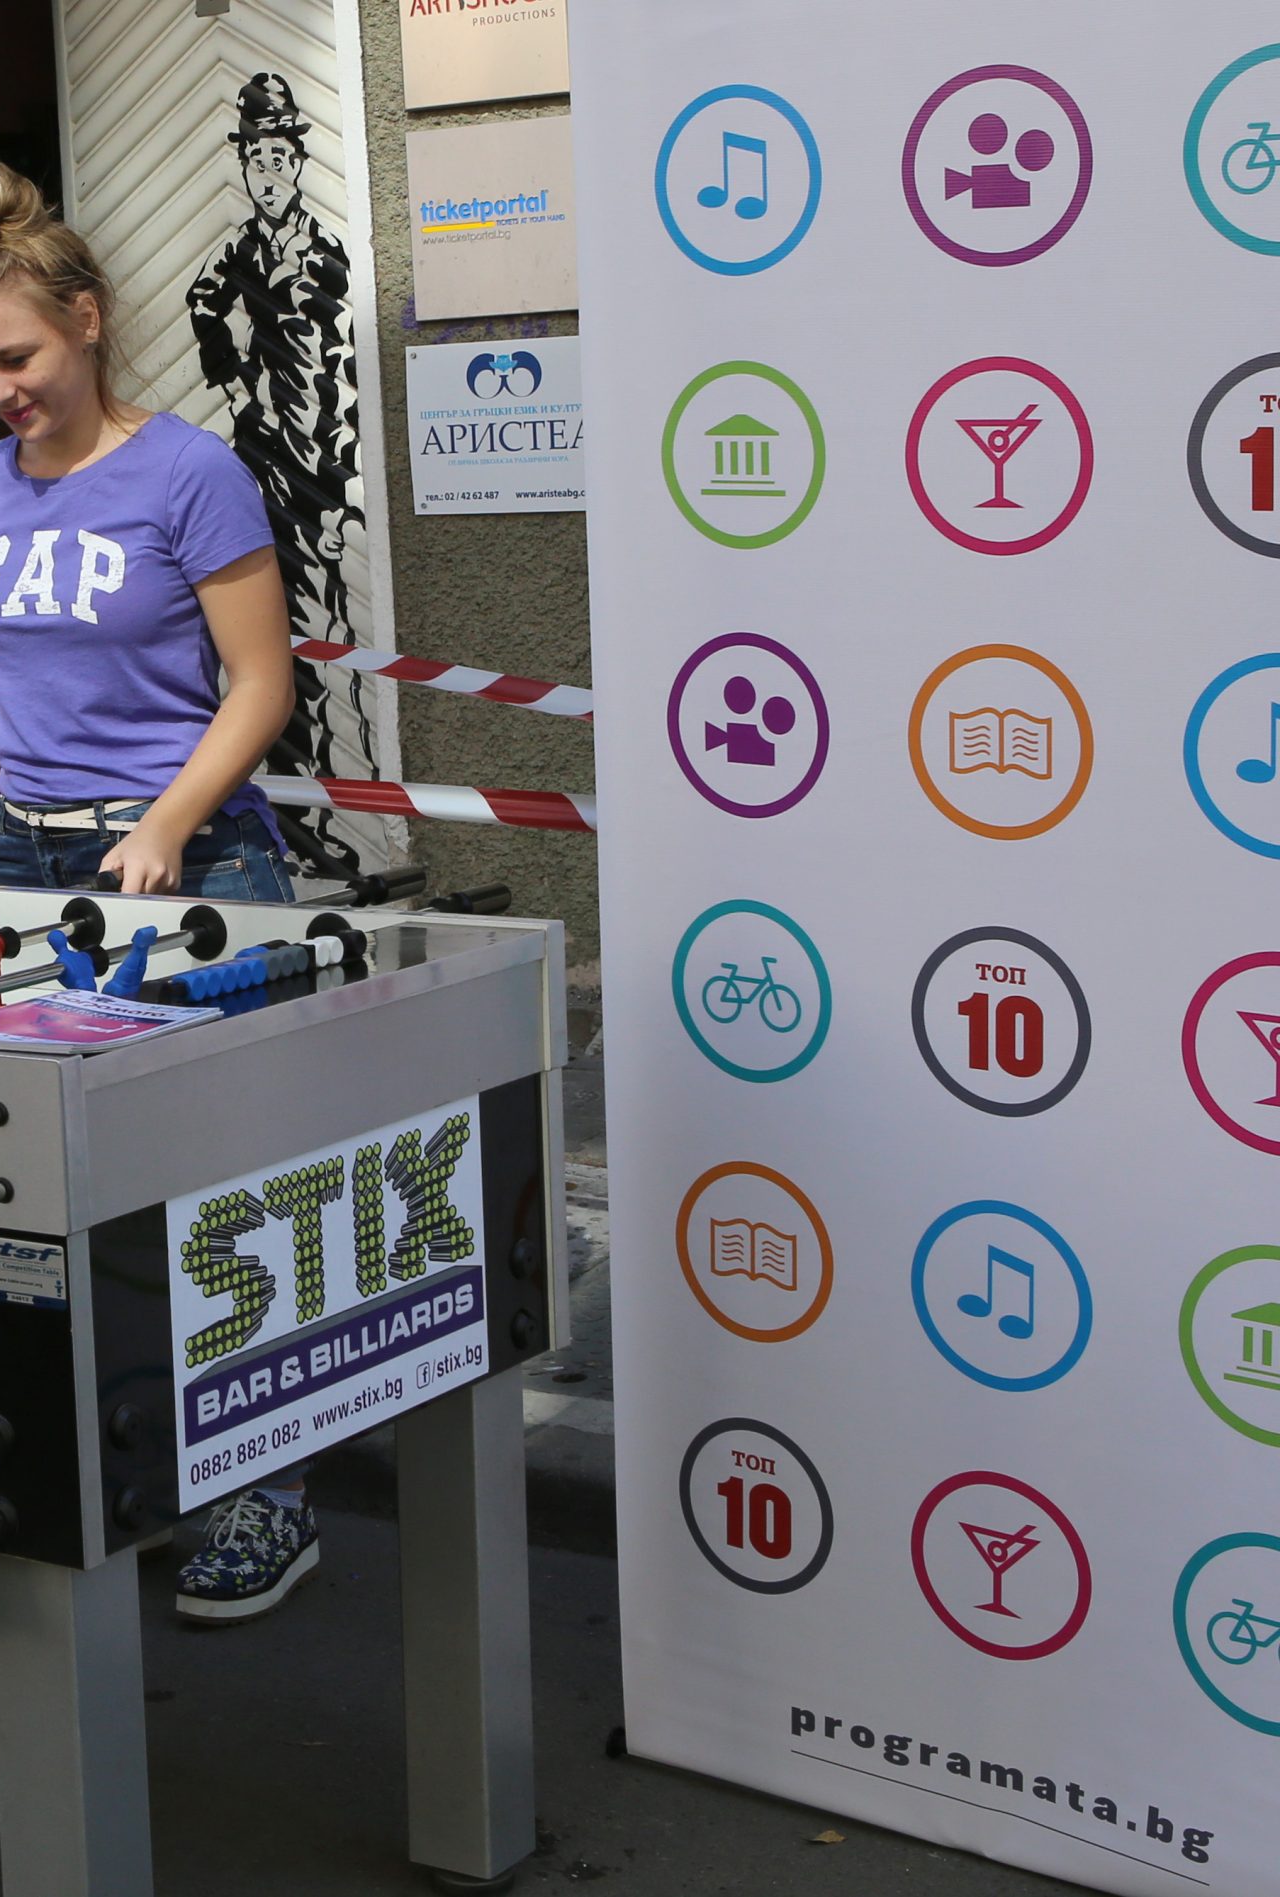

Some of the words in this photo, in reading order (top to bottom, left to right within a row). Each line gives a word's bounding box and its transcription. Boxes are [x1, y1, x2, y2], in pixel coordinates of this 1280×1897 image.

[472, 7, 556, 27] PRODUCTIONS
[420, 190, 548, 224] ticketportal
[496, 217, 519, 226] TICKETS
[520, 217, 529, 225] AT
[529, 215, 546, 224] YOUR
[547, 213, 566, 222] HAND
[422, 230, 512, 246] www.ticketportal.bg
[420, 410, 458, 420] ЦЕНТЪР
[459, 409, 471, 417] ЗА
[473, 406, 512, 417] ГРЪЦКИ
[514, 405, 538, 415] ЕЗИК
[540, 405, 548, 413] И
[425, 493, 443, 501] тел.:
[445, 492, 455, 500] 02
[461, 492, 471, 500] 42
[472, 491, 483, 500] 62
[484, 491, 499, 500] 487
[975, 962, 1026, 986] ТОП
[957, 992, 1044, 1078] 10
[180, 1111, 475, 1369] STIX
[2, 1262, 41, 1273] Competition
[196, 1367, 273, 1427] BAR
[279, 1354, 305, 1392] &
[310, 1283, 475, 1380] BILLIARDS
[190, 1449, 232, 1486] 0882
[236, 1435, 267, 1467] 882
[271, 1419, 301, 1450] 082
[313, 1375, 404, 1431] www.stix.bg
[731, 1450, 776, 1476] ТОП
[716, 1475, 792, 1560] 10
[791, 1706, 1214, 1864] programata.bg
